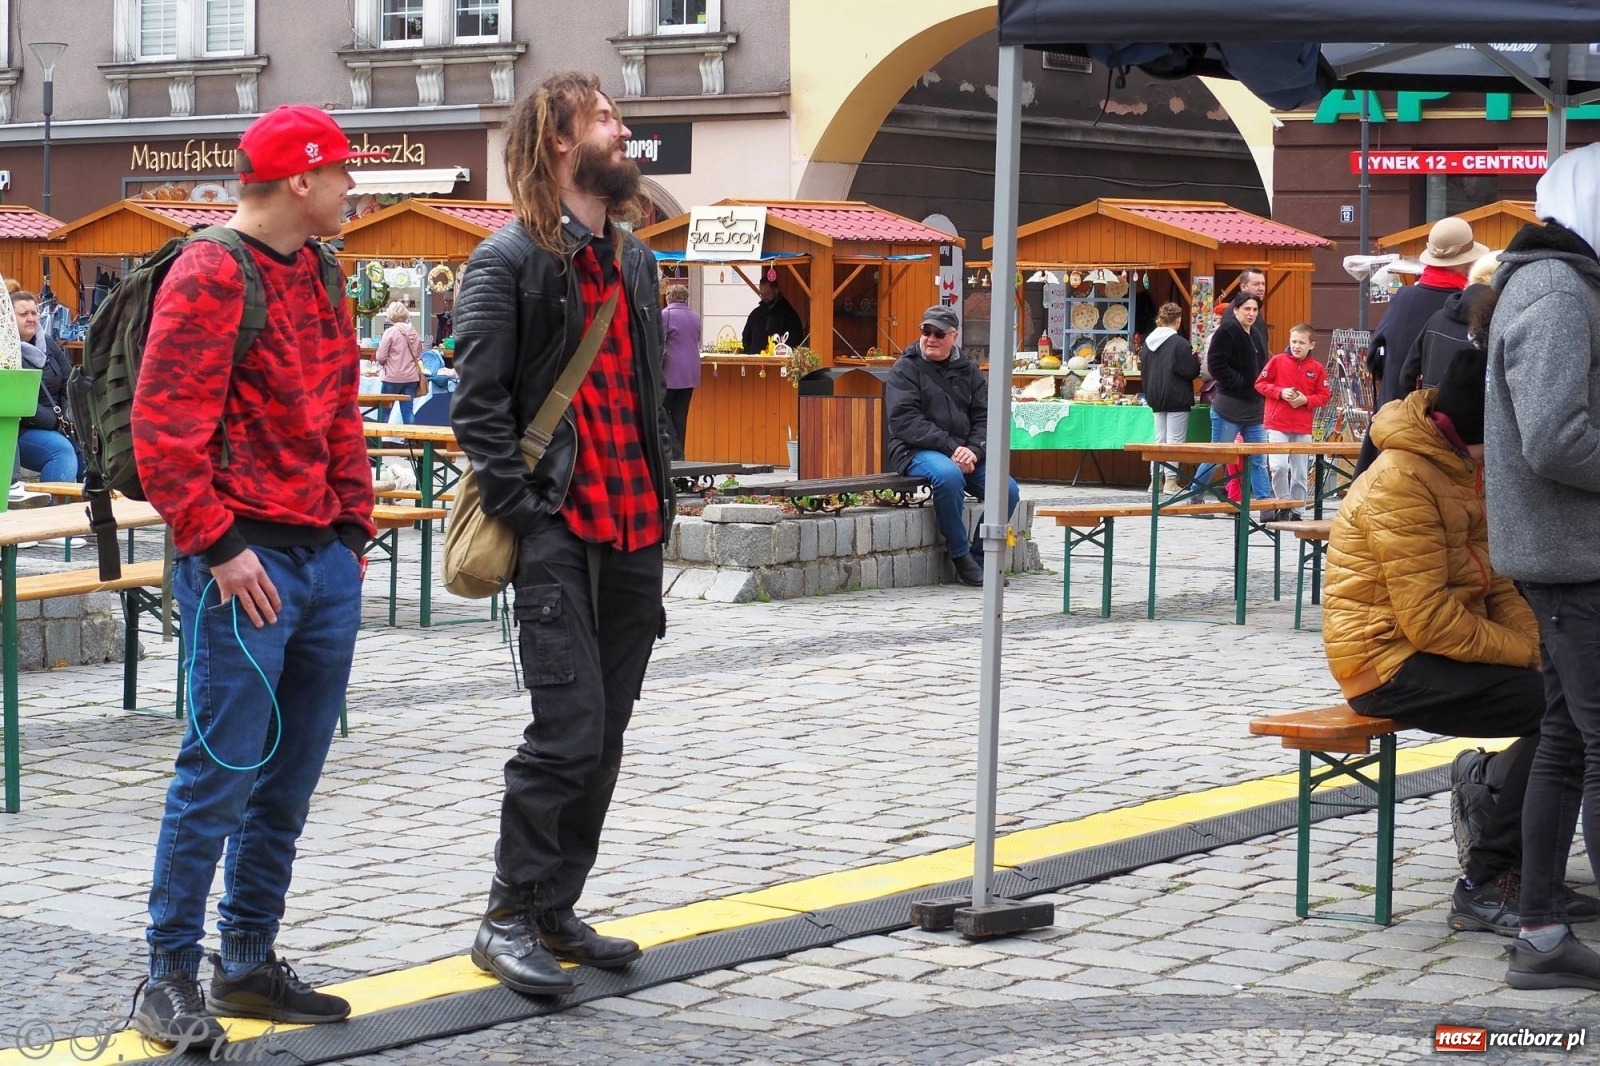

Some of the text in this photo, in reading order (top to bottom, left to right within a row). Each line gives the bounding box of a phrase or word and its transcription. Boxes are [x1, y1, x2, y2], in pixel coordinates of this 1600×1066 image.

[345, 132, 425, 167] ałeczka
[1425, 155, 1447, 170] 12
[1342, 211, 1351, 219] 12
